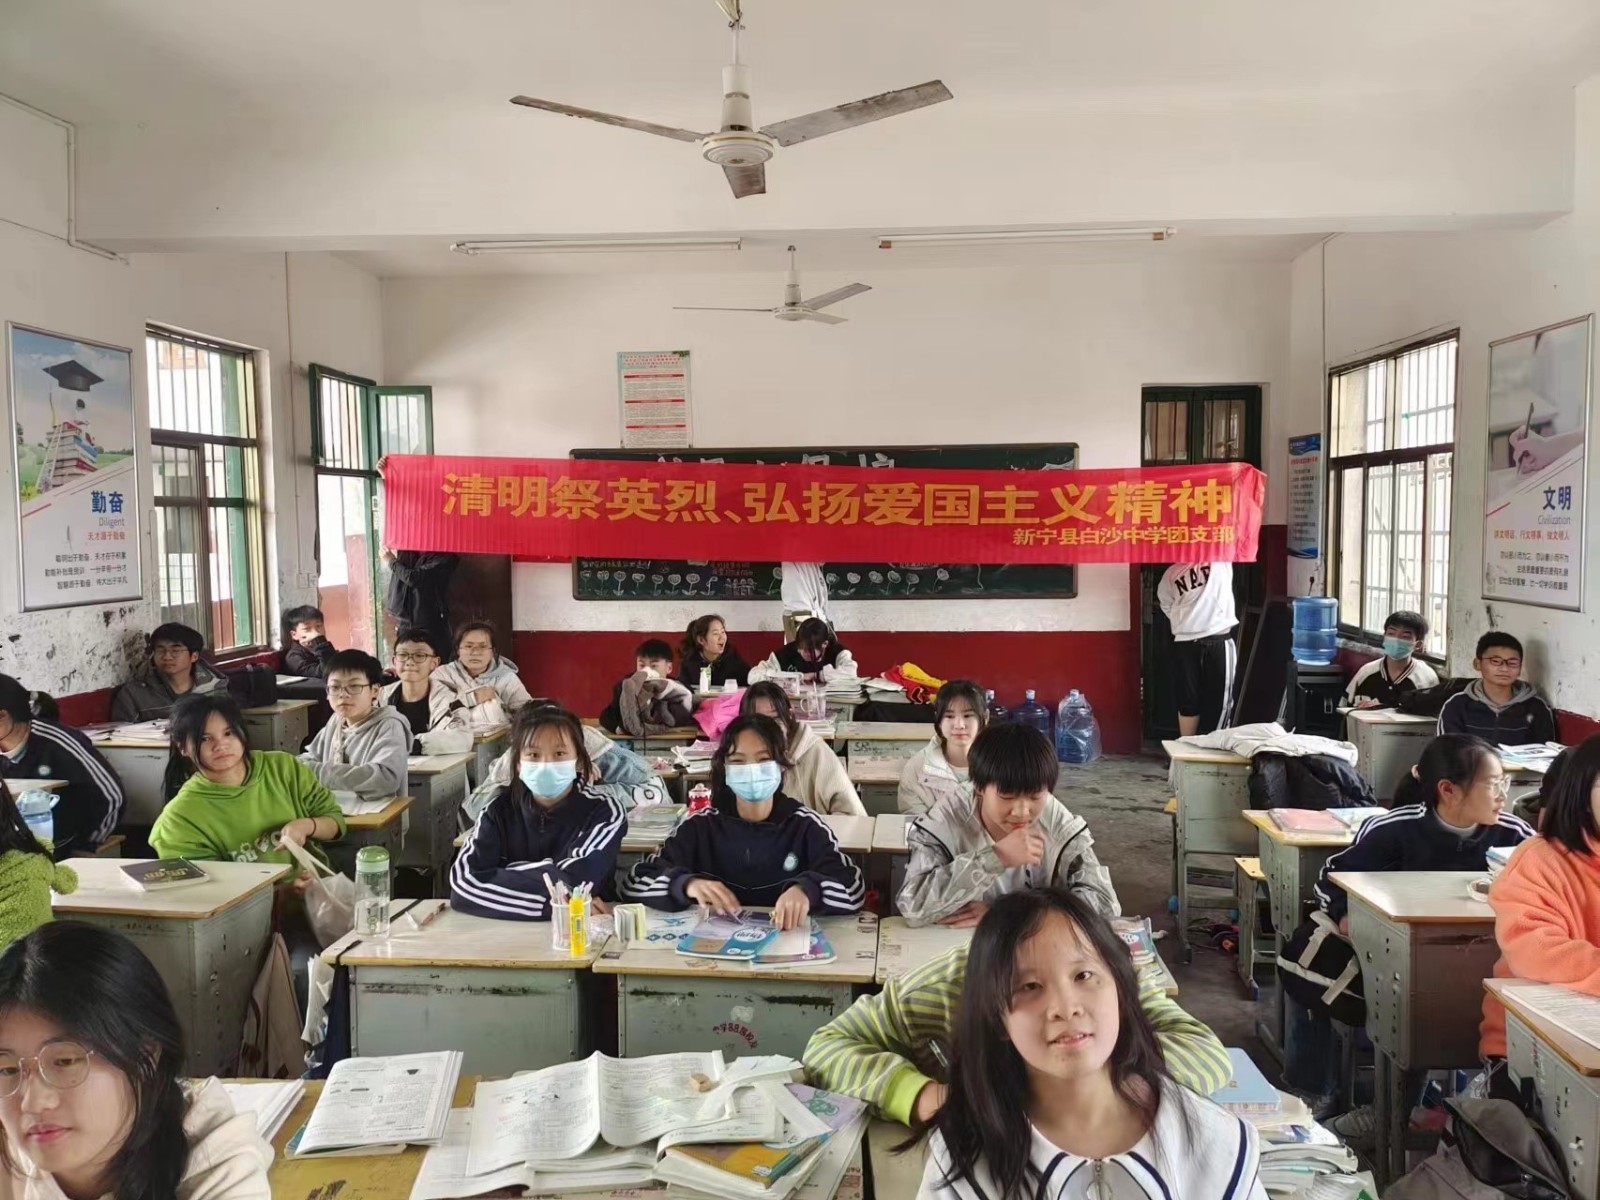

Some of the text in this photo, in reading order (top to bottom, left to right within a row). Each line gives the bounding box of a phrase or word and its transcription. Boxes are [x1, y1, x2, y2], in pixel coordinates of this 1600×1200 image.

[91, 490, 124, 514] 勤奋
[440, 472, 1232, 527] 清明祭英烈、弘扬爱国主义精神
[1543, 485, 1571, 510] 文明
[98, 516, 125, 528] Diligent
[1012, 525, 1235, 546] 新宁县白沙中学团支部
